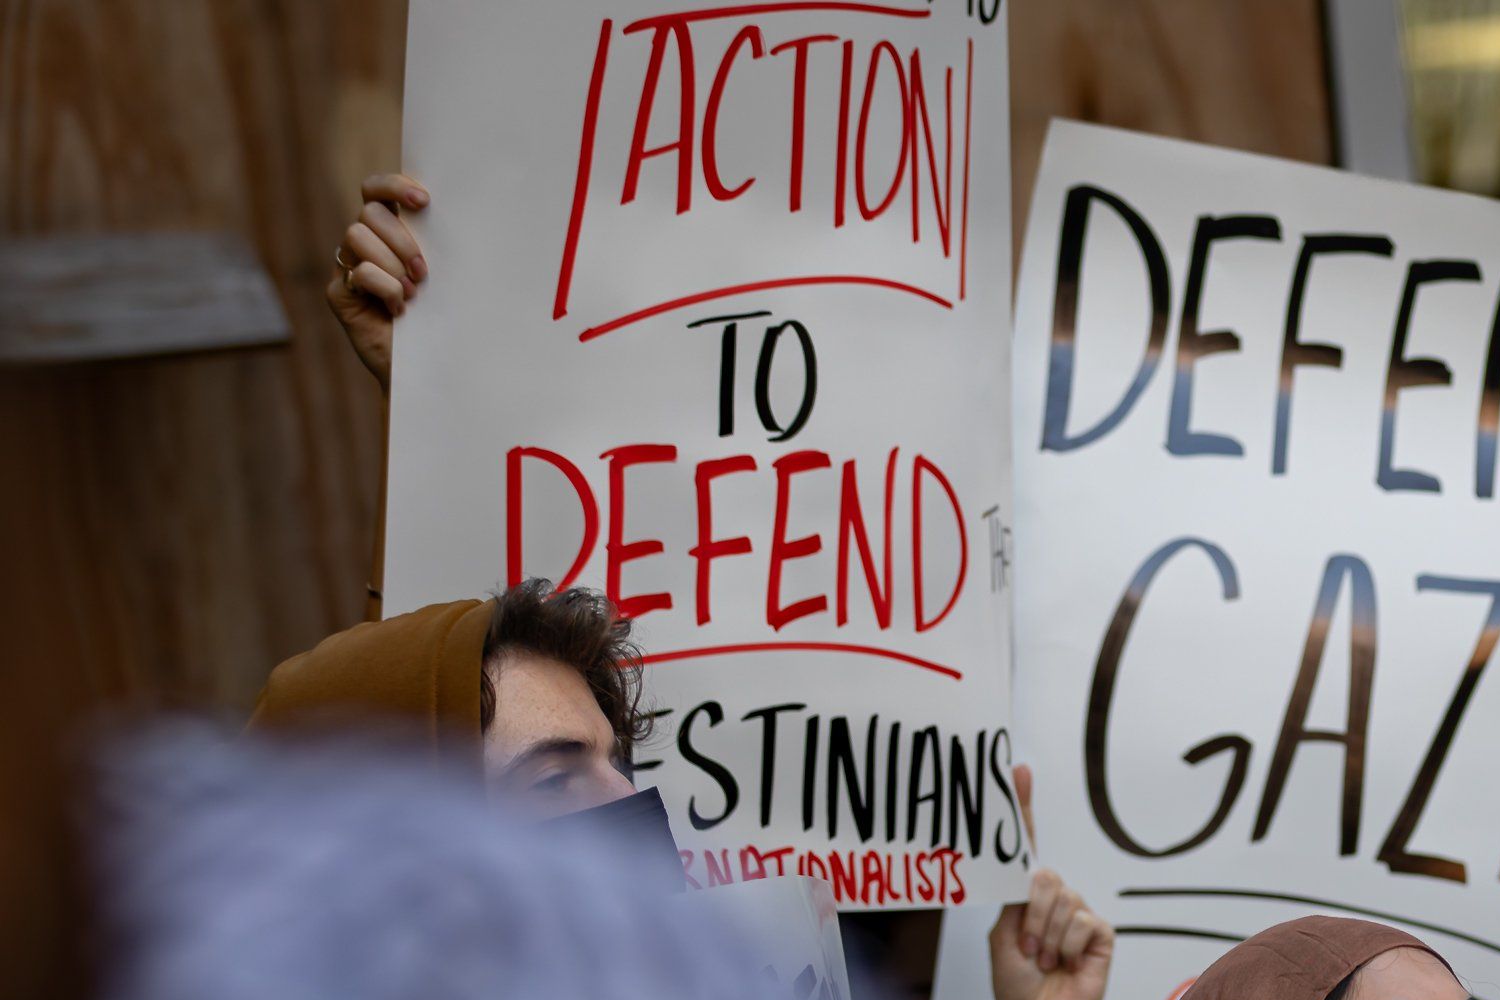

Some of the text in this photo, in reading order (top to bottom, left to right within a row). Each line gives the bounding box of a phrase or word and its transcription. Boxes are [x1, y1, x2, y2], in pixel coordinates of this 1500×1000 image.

[620, 18, 953, 258] ACTION
[687, 311, 818, 442] TO
[506, 444, 968, 633] DEFEND
